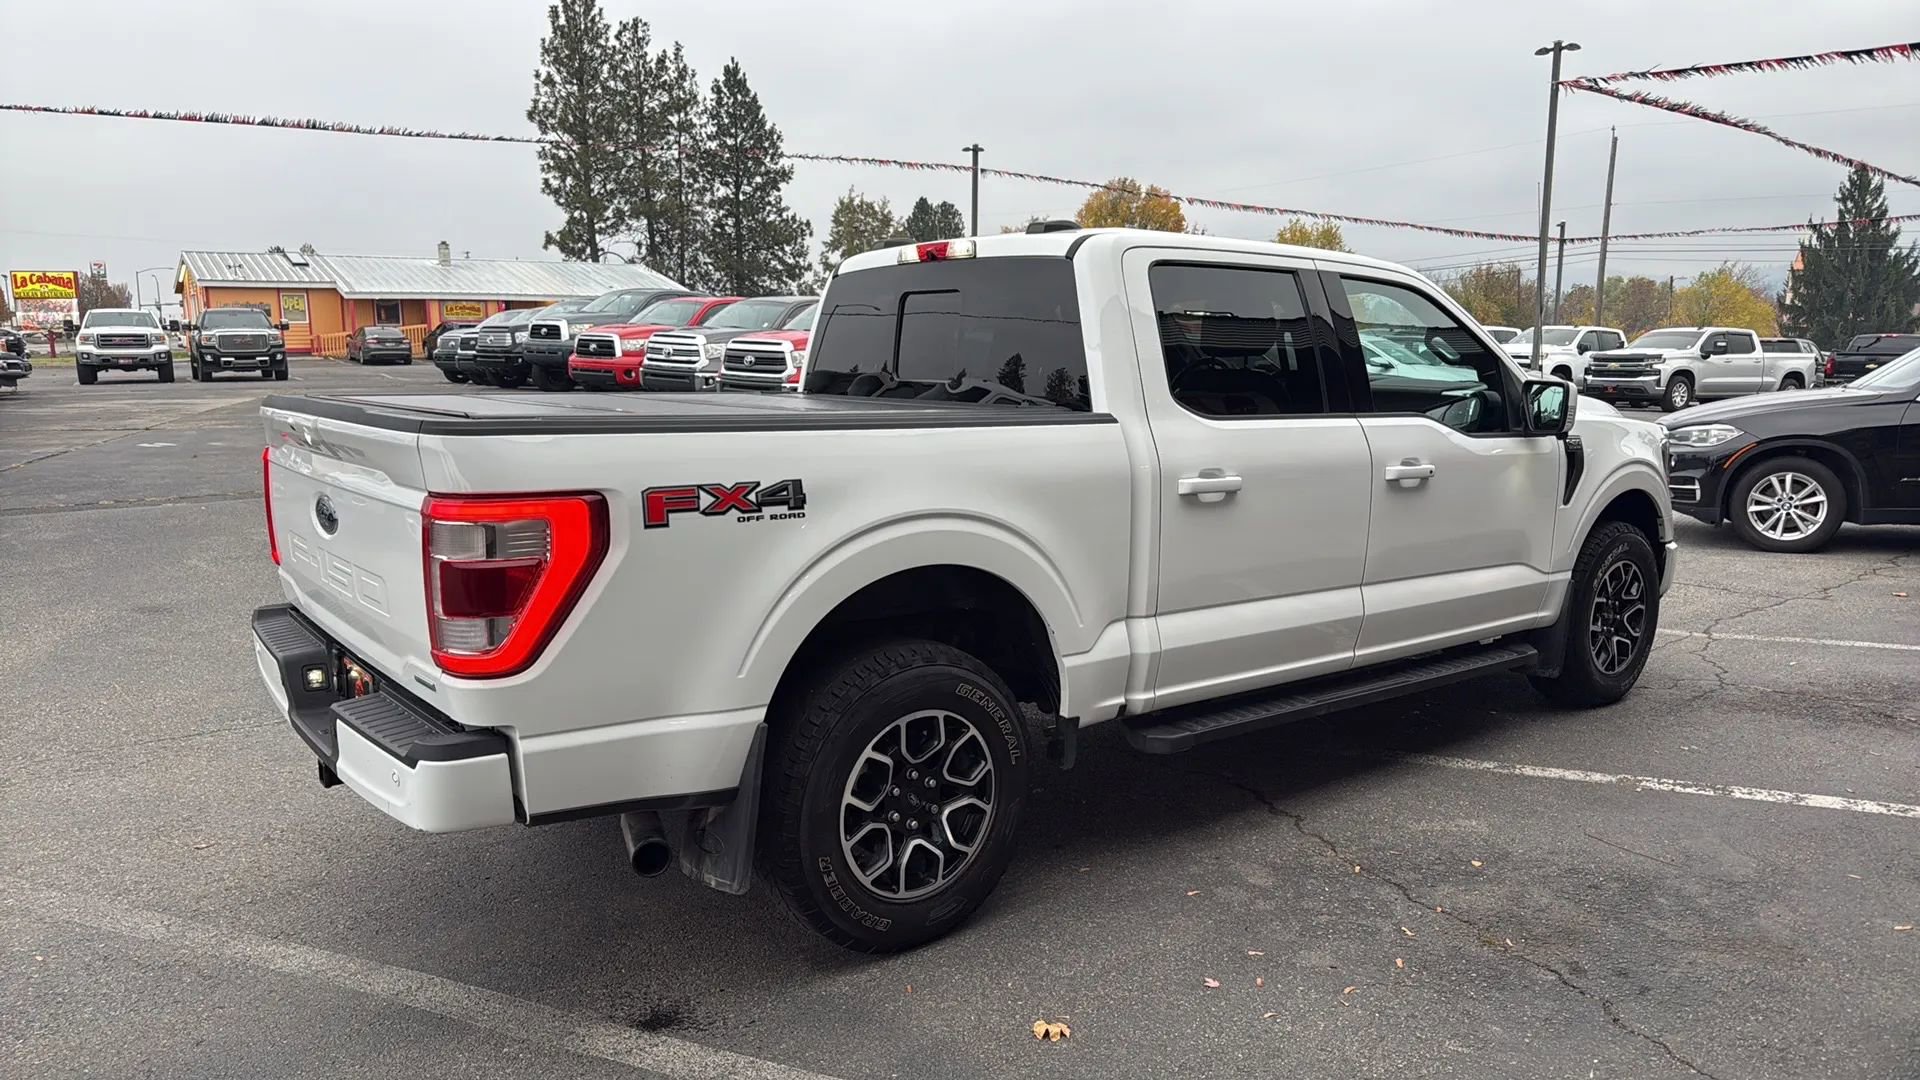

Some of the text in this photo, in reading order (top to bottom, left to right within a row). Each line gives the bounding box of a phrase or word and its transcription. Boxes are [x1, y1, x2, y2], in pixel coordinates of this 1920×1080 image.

[13, 274, 28, 289] La
[283, 296, 305, 311] OPEN
[641, 479, 807, 529] FX4
[737, 512, 806, 523] OFF ROAD
[288, 530, 391, 617] F-150
[955, 683, 1024, 765] GENERAL
[818, 856, 892, 932] GRABBER
